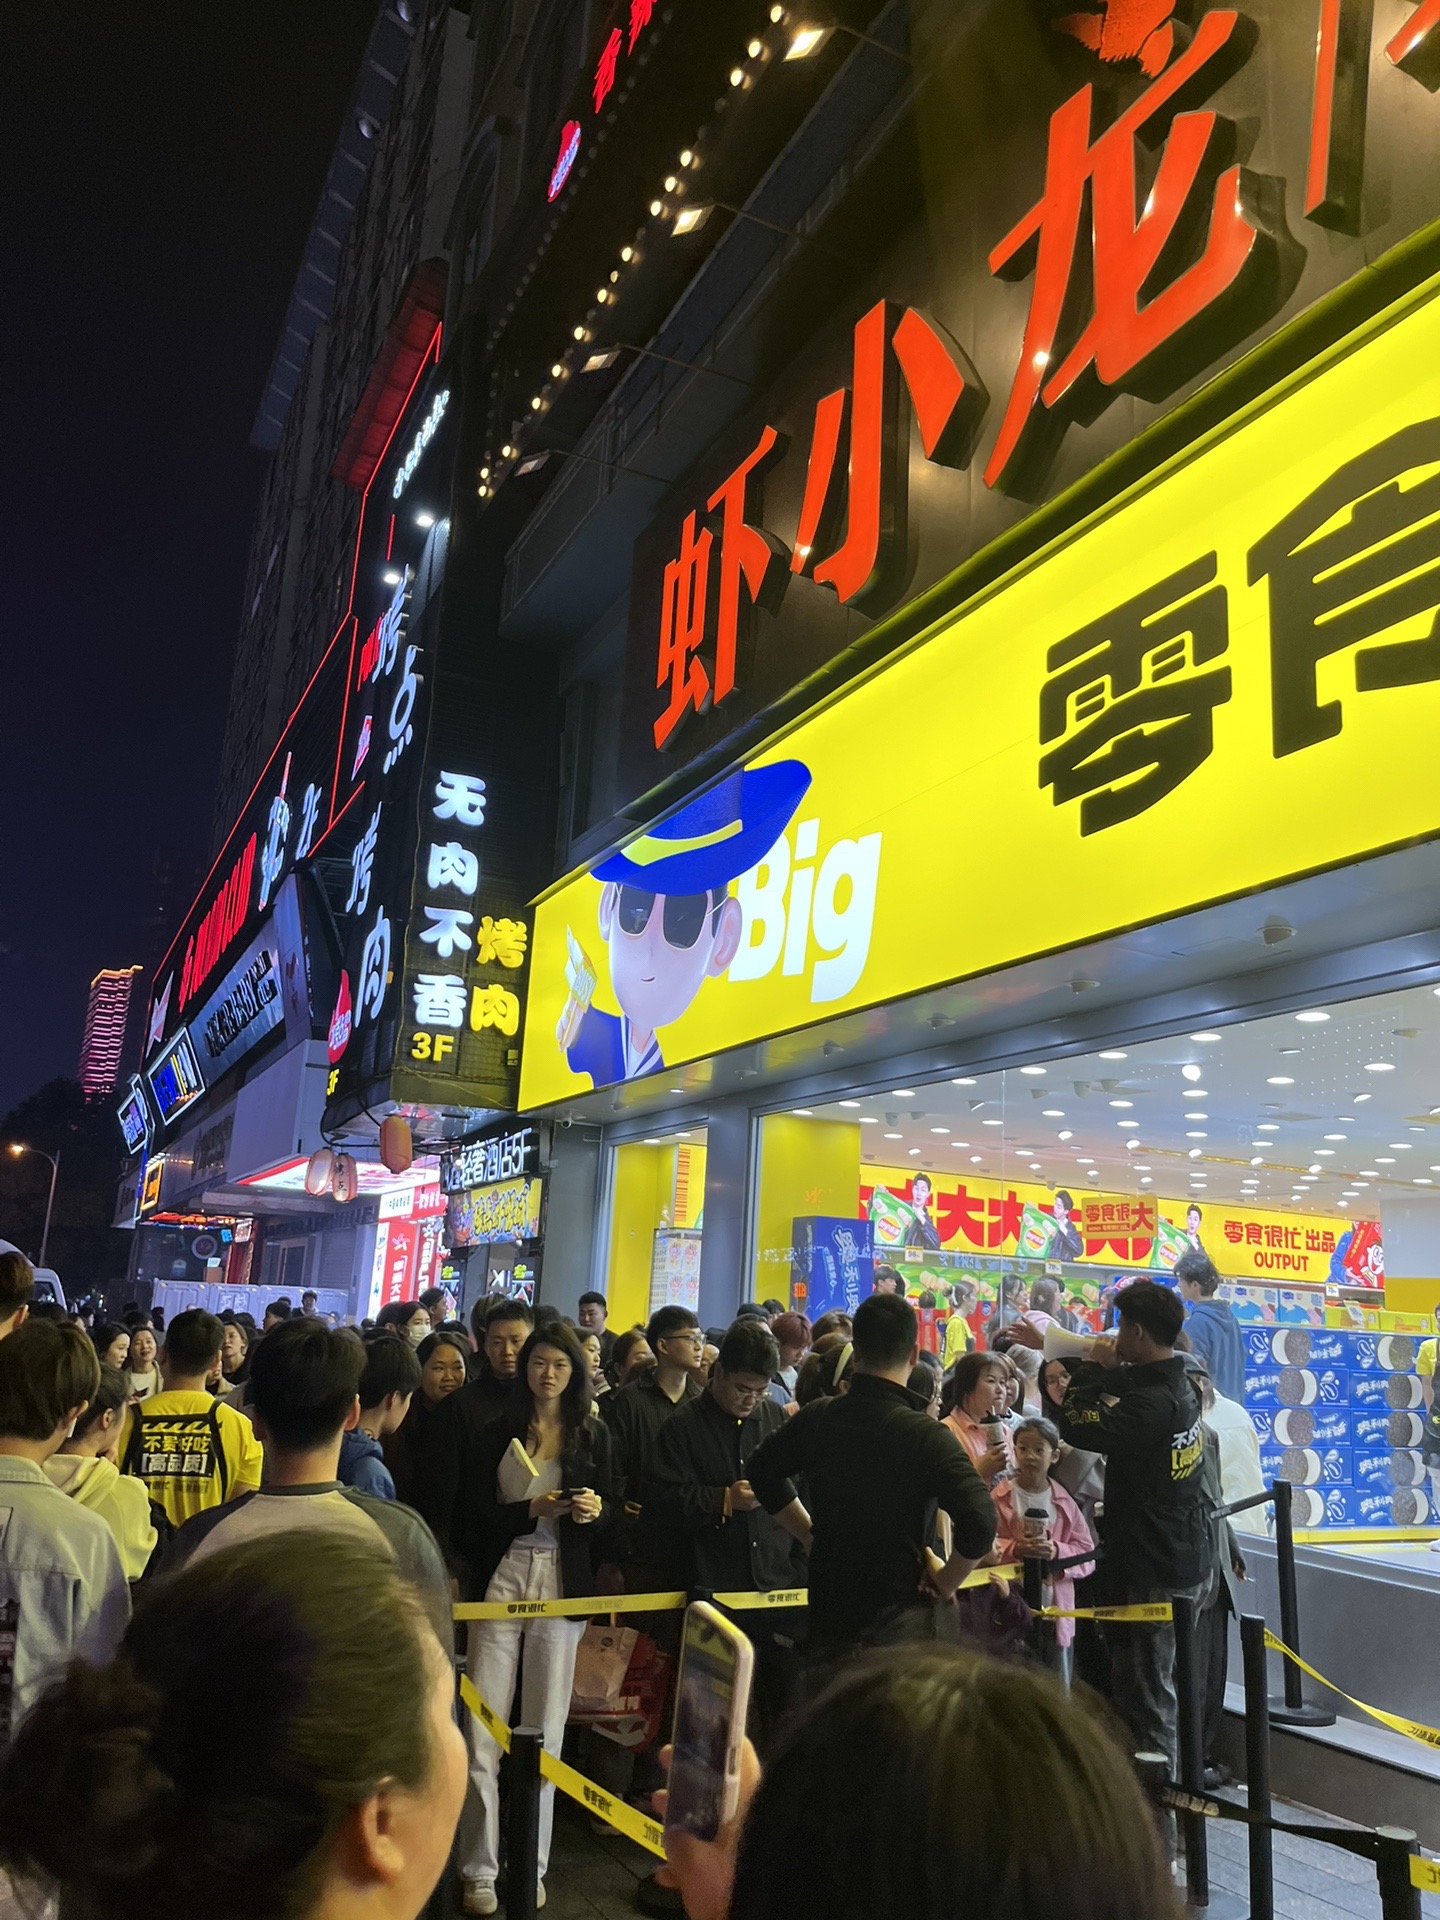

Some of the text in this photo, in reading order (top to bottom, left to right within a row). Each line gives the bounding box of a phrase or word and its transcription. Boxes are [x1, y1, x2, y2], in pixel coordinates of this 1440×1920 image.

[413, 770, 487, 1028] 无肉不香
[728, 817, 882, 1003] Big
[470, 915, 527, 1036] 烤肉
[411, 1032, 455, 1062] 3F
[1254, 1251, 1309, 1272] OUTPUT
[143, 1435, 211, 1452] 不贵好吃
